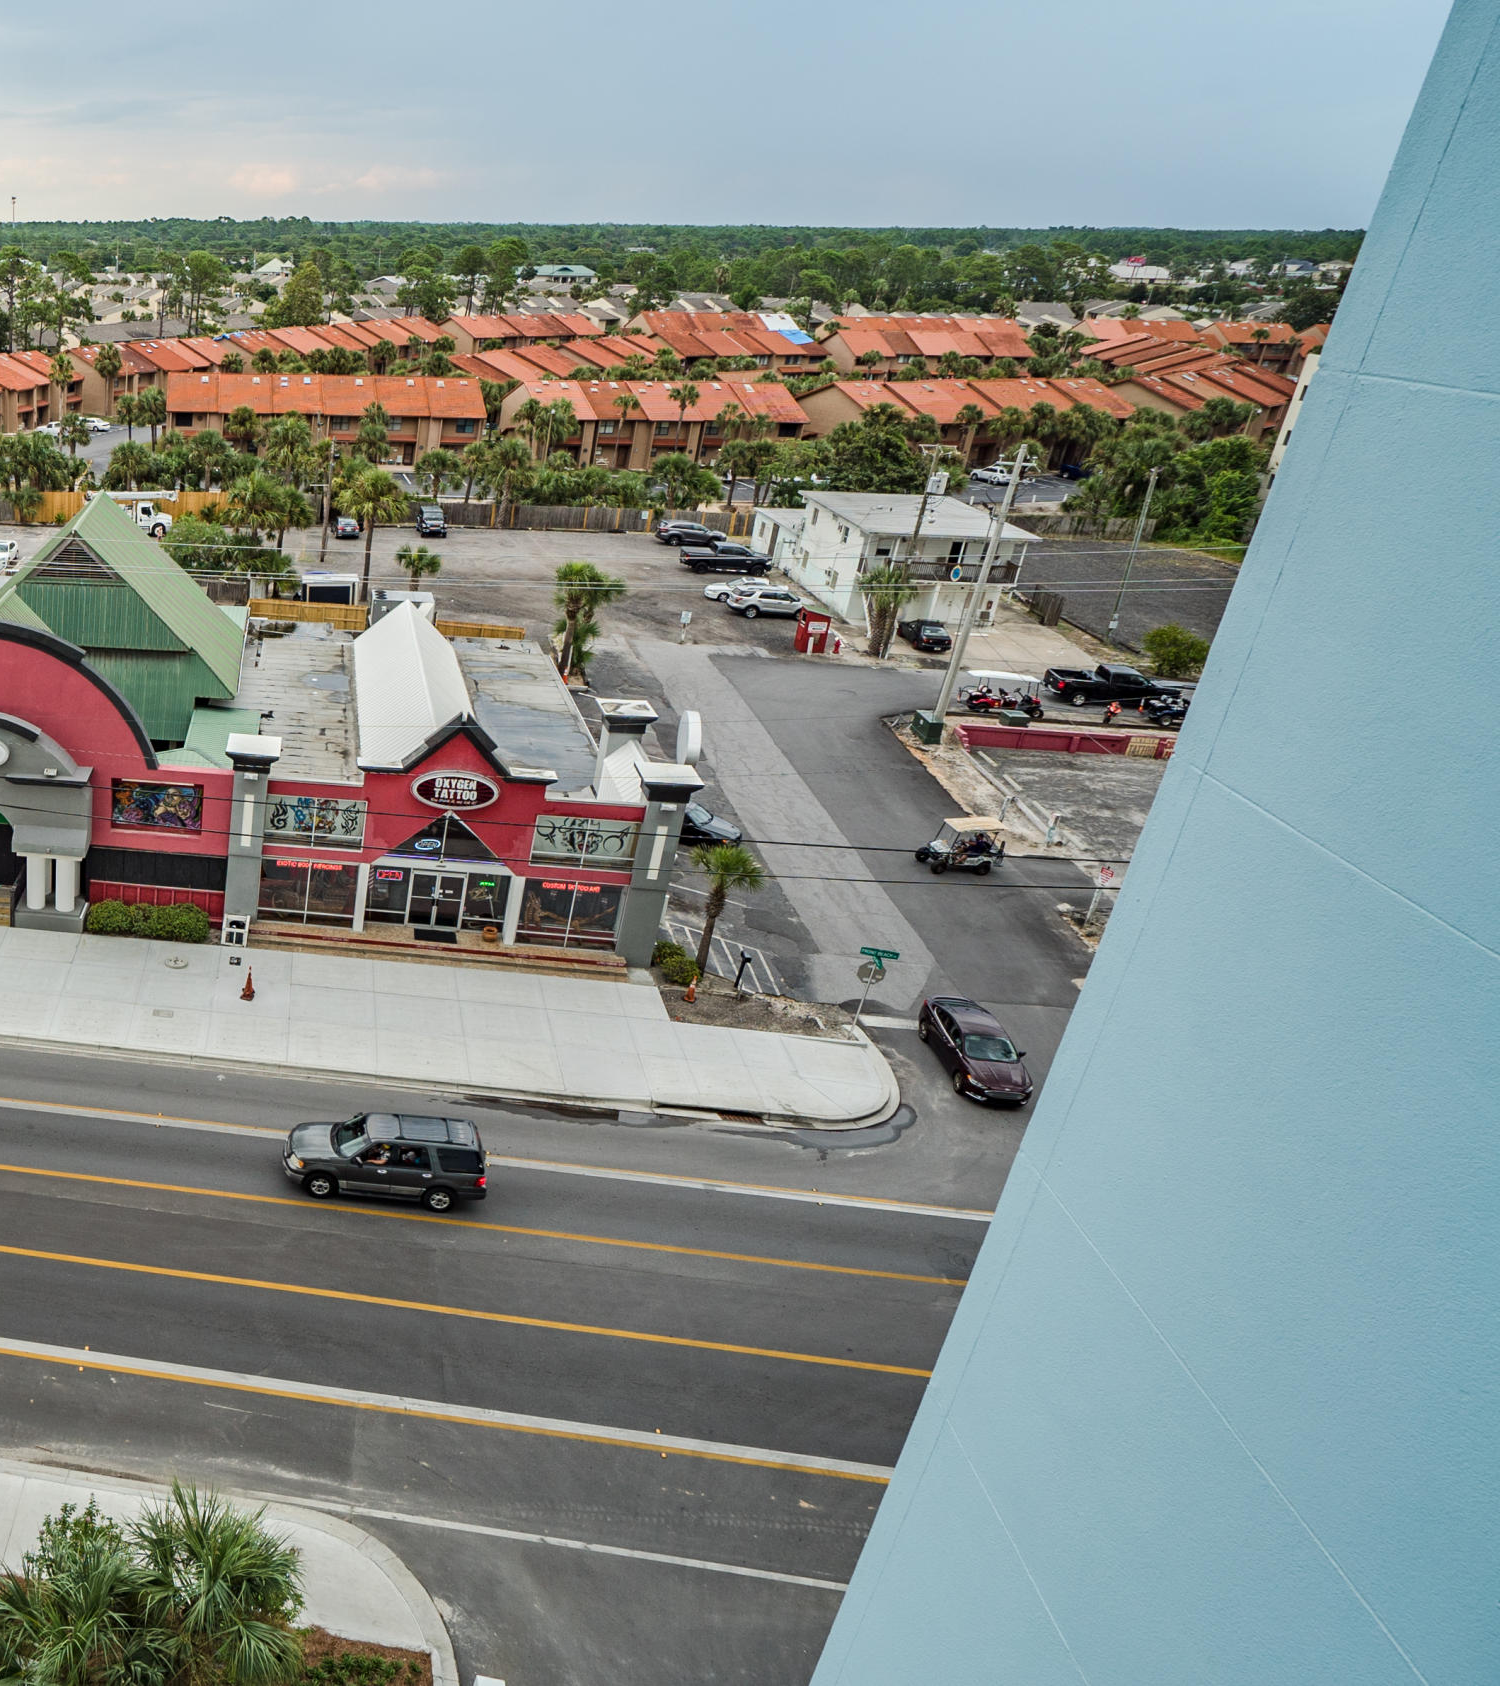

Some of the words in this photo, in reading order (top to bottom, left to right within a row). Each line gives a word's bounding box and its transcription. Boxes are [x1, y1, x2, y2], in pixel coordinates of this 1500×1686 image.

[434, 777, 477, 791] OXYGEN
[433, 788, 478, 801] TATTOO
[276, 859, 297, 868] EXOTIC
[313, 862, 343, 871] PIERCINGS
[378, 870, 403, 880] OPEN
[542, 881, 567, 890] CUSTOM
[588, 885, 601, 894] ART
